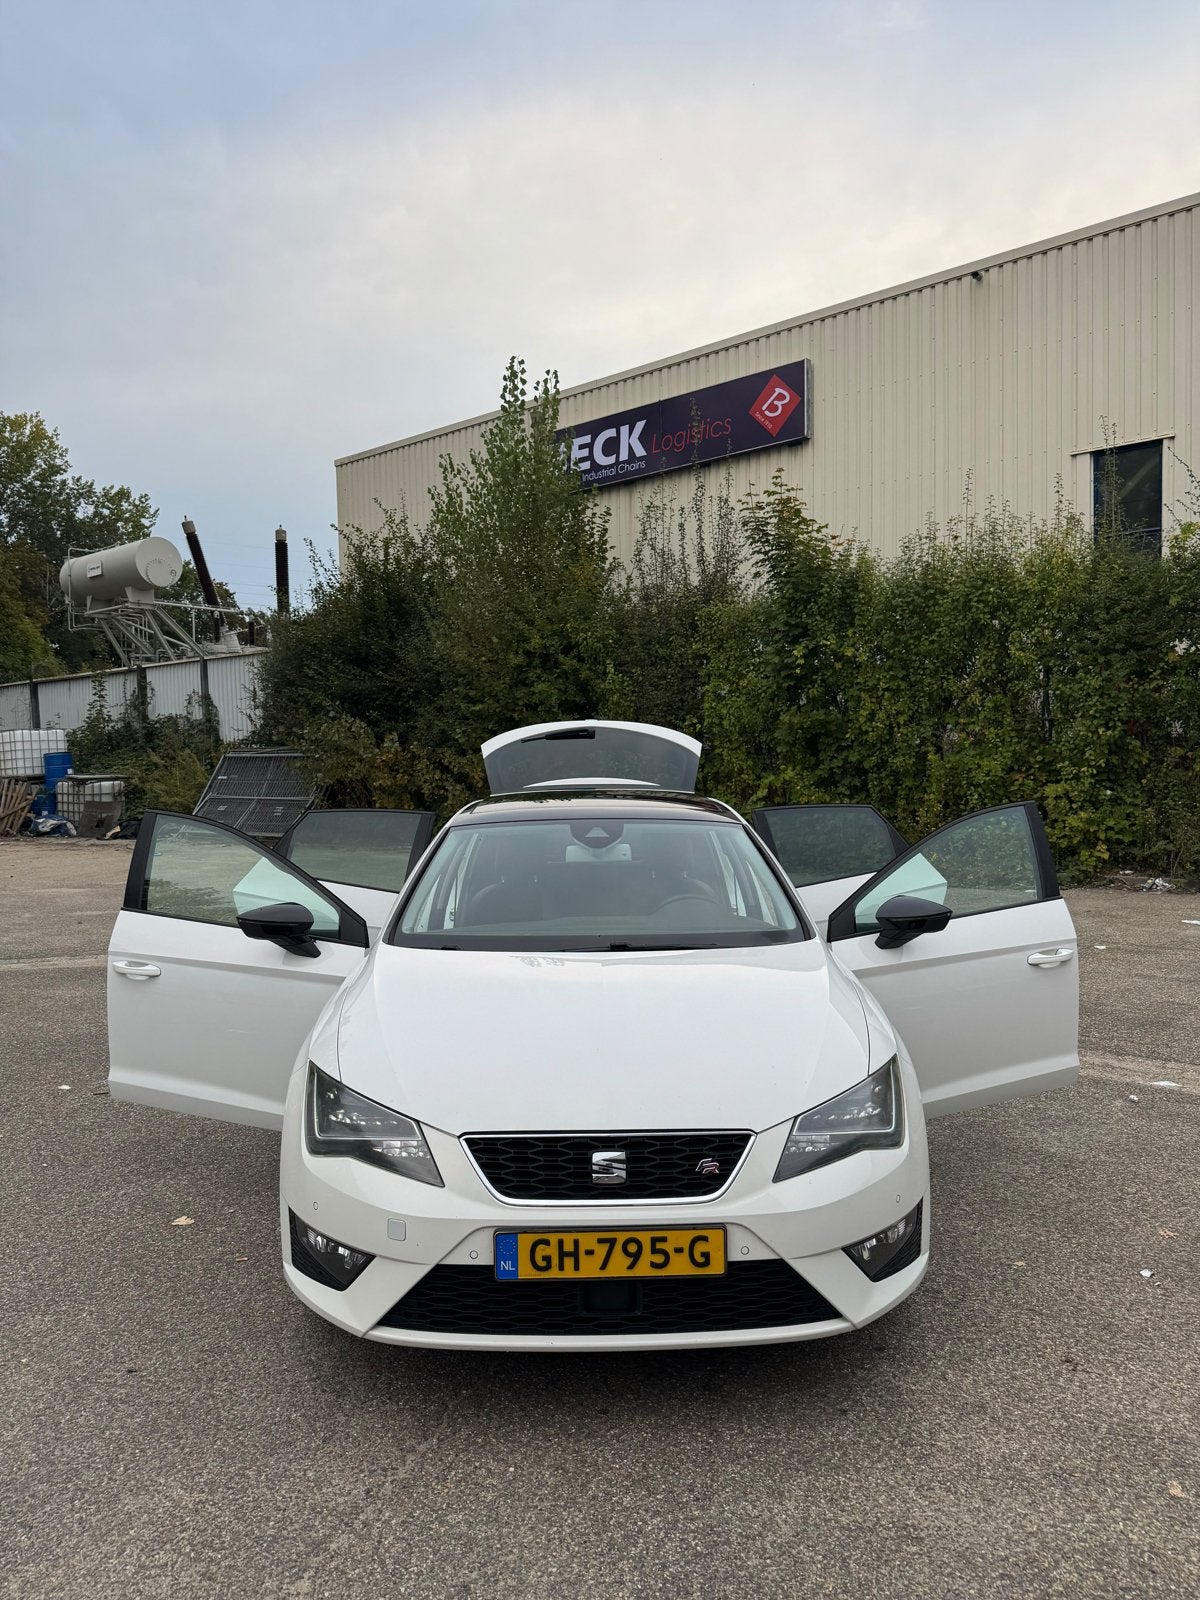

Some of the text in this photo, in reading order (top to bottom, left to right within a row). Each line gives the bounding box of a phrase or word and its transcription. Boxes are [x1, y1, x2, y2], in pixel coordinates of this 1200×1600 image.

[762, 387, 790, 417] B
[558, 417, 732, 472] ECK Logistics
[582, 460, 646, 482] Industrial Chains
[500, 1235, 711, 1272] NL GH-795-G
